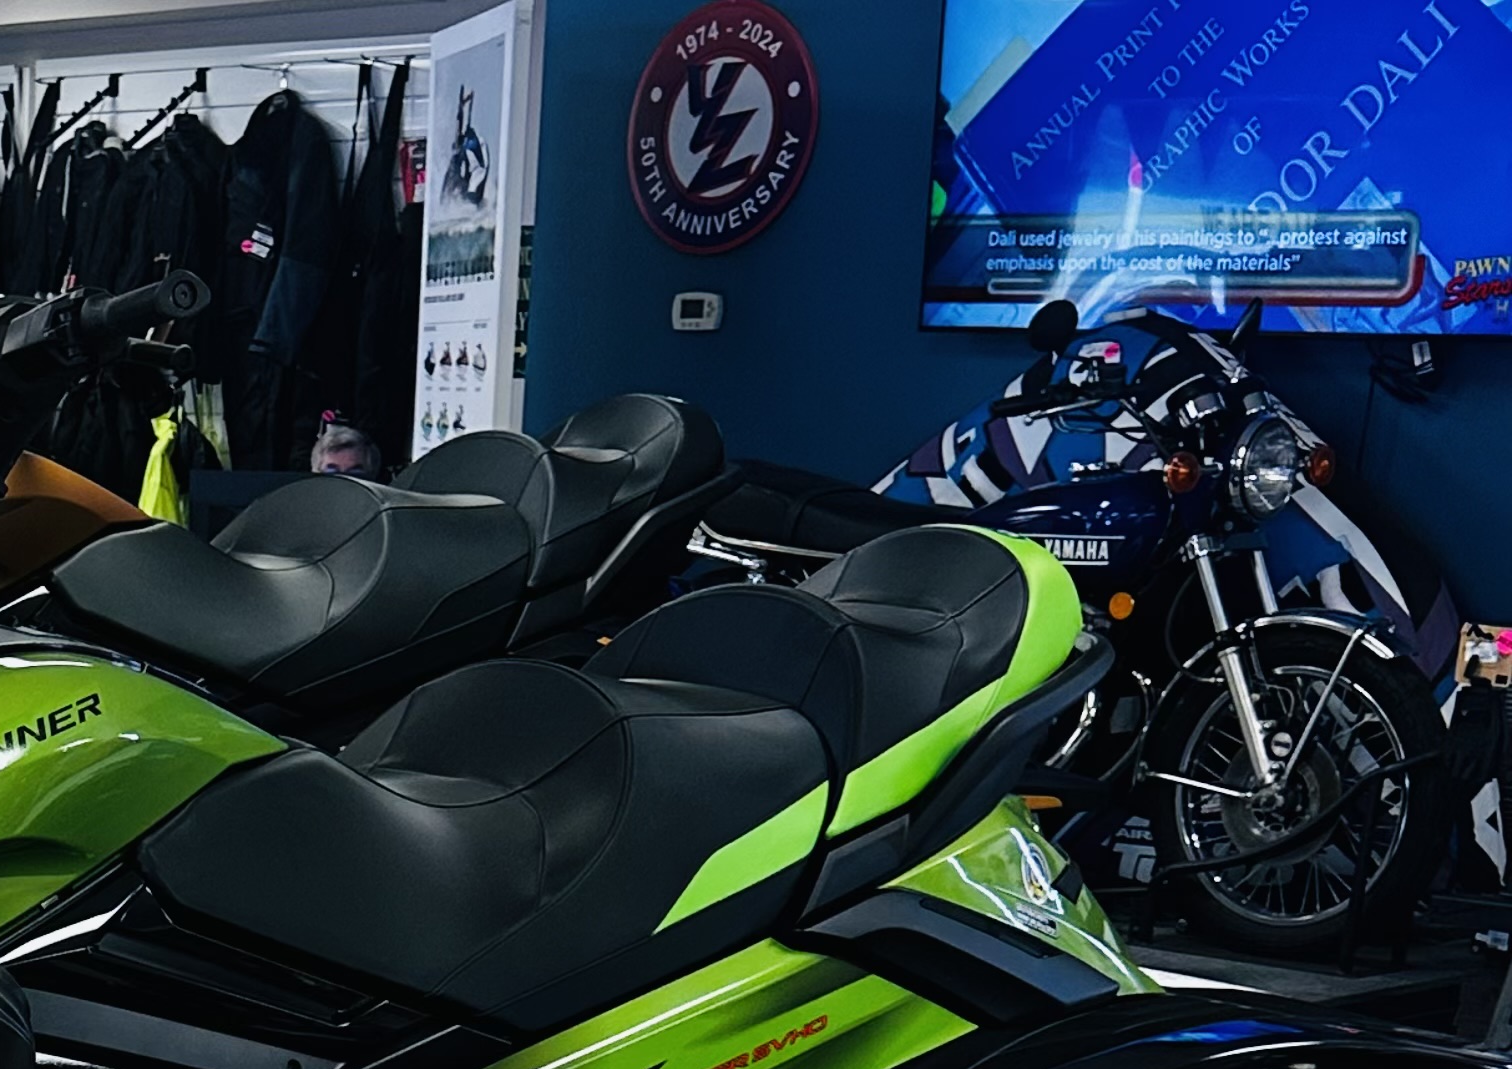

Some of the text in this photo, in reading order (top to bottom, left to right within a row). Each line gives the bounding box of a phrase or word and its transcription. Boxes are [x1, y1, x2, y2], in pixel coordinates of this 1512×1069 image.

[676, 20, 719, 60] 1974
[739, 19, 783, 58] 2024
[1148, 17, 1225, 99] TO THE
[1220, 0, 1310, 86] WORKS
[1340, 0, 1460, 133] DALI
[1011, 7, 1164, 180] ANNUAL PRINT
[1233, 116, 1262, 155] OF
[640, 130, 800, 235] 50TH ANNIVERSARY
[1019, 230, 1056, 247] used
[1057, 230, 1114, 249] jewelry
[1135, 229, 1157, 246] his
[1159, 228, 1237, 249] paintings
[1237, 229, 1255, 245] to
[1344, 227, 1407, 248] against
[986, 255, 1055, 273] emphasis
[1058, 258, 1098, 273] upon
[1101, 255, 1126, 271] the
[1129, 255, 1163, 272] cost
[1166, 254, 1185, 271] of
[1186, 254, 1213, 271] the
[1454, 256, 1511, 277] PAWN
[1044, 538, 1109, 560] YAMAHA
